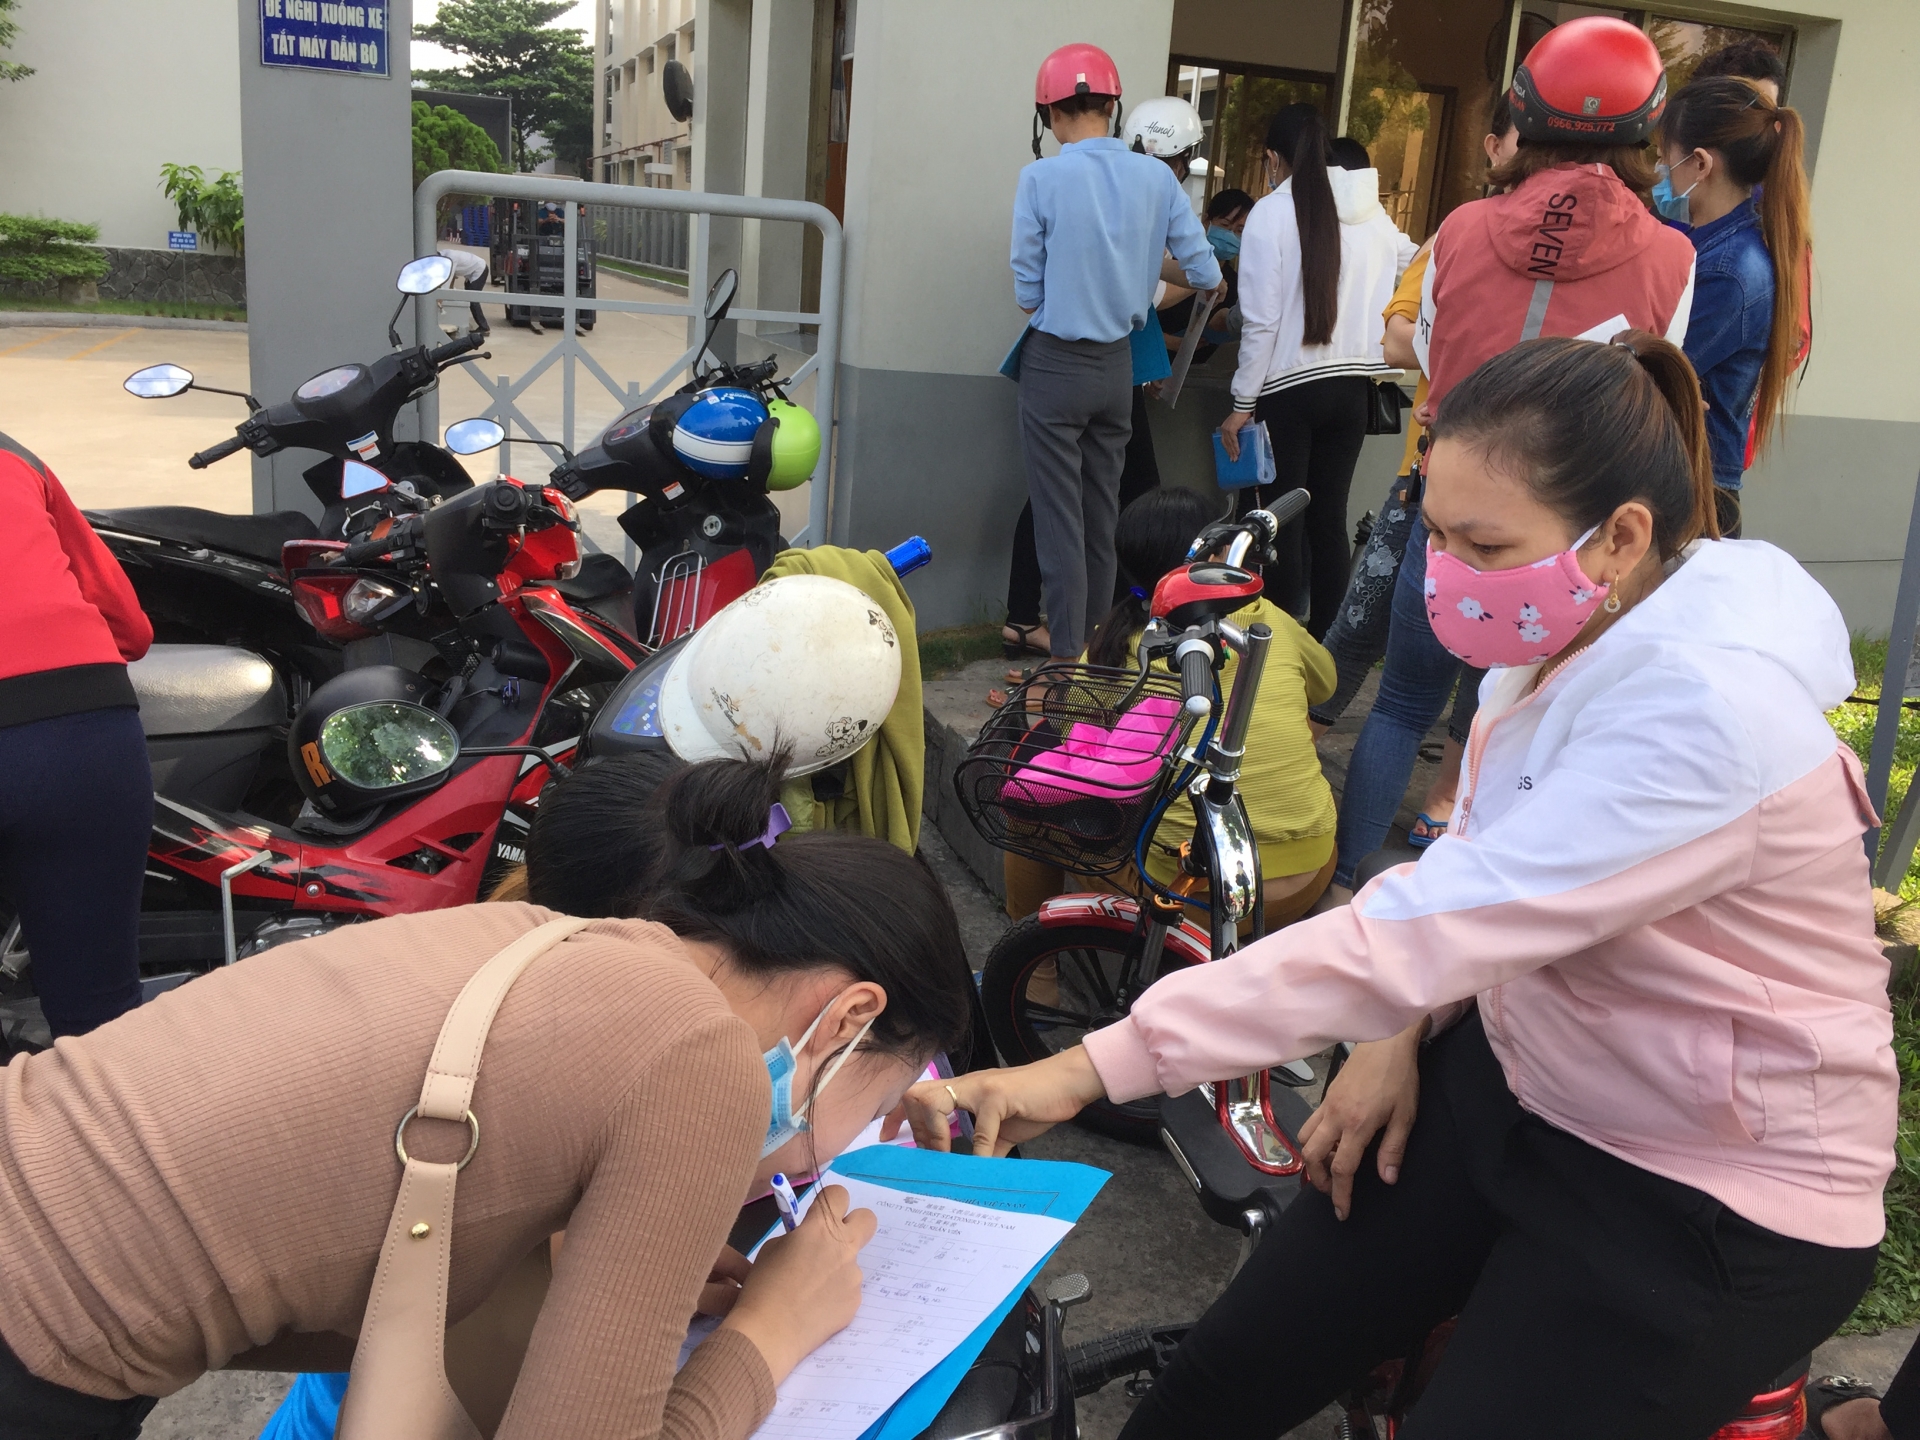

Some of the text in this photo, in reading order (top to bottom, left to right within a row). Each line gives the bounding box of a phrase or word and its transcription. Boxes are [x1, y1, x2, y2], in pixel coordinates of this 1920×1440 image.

[285, 0, 317, 26] NGHỊ
[321, 0, 365, 27] XUỐNG
[368, 7, 383, 29] XE
[271, 29, 378, 69] TẮT MÁY DẪN BỘ
[1144, 121, 1175, 138] Hanoi
[1527, 193, 1577, 276] SEVEN
